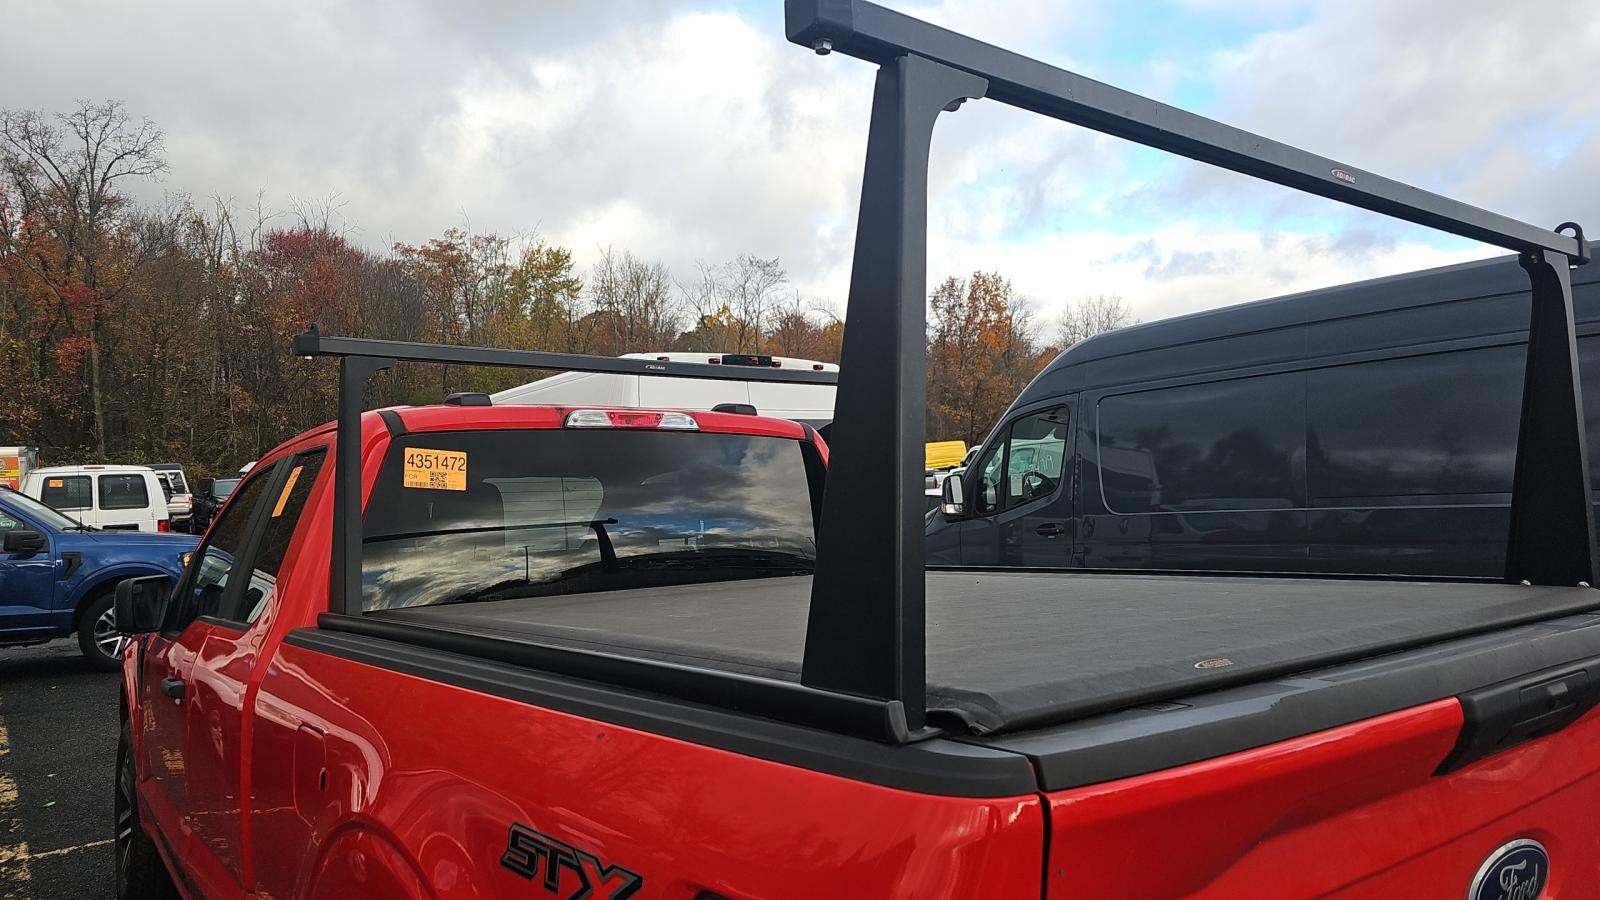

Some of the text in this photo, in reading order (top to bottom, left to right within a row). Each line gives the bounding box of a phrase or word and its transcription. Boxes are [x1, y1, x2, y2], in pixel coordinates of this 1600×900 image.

[407, 453, 466, 471] 4351472
[500, 822, 643, 900] STX
[1499, 859, 1539, 900] Ford
